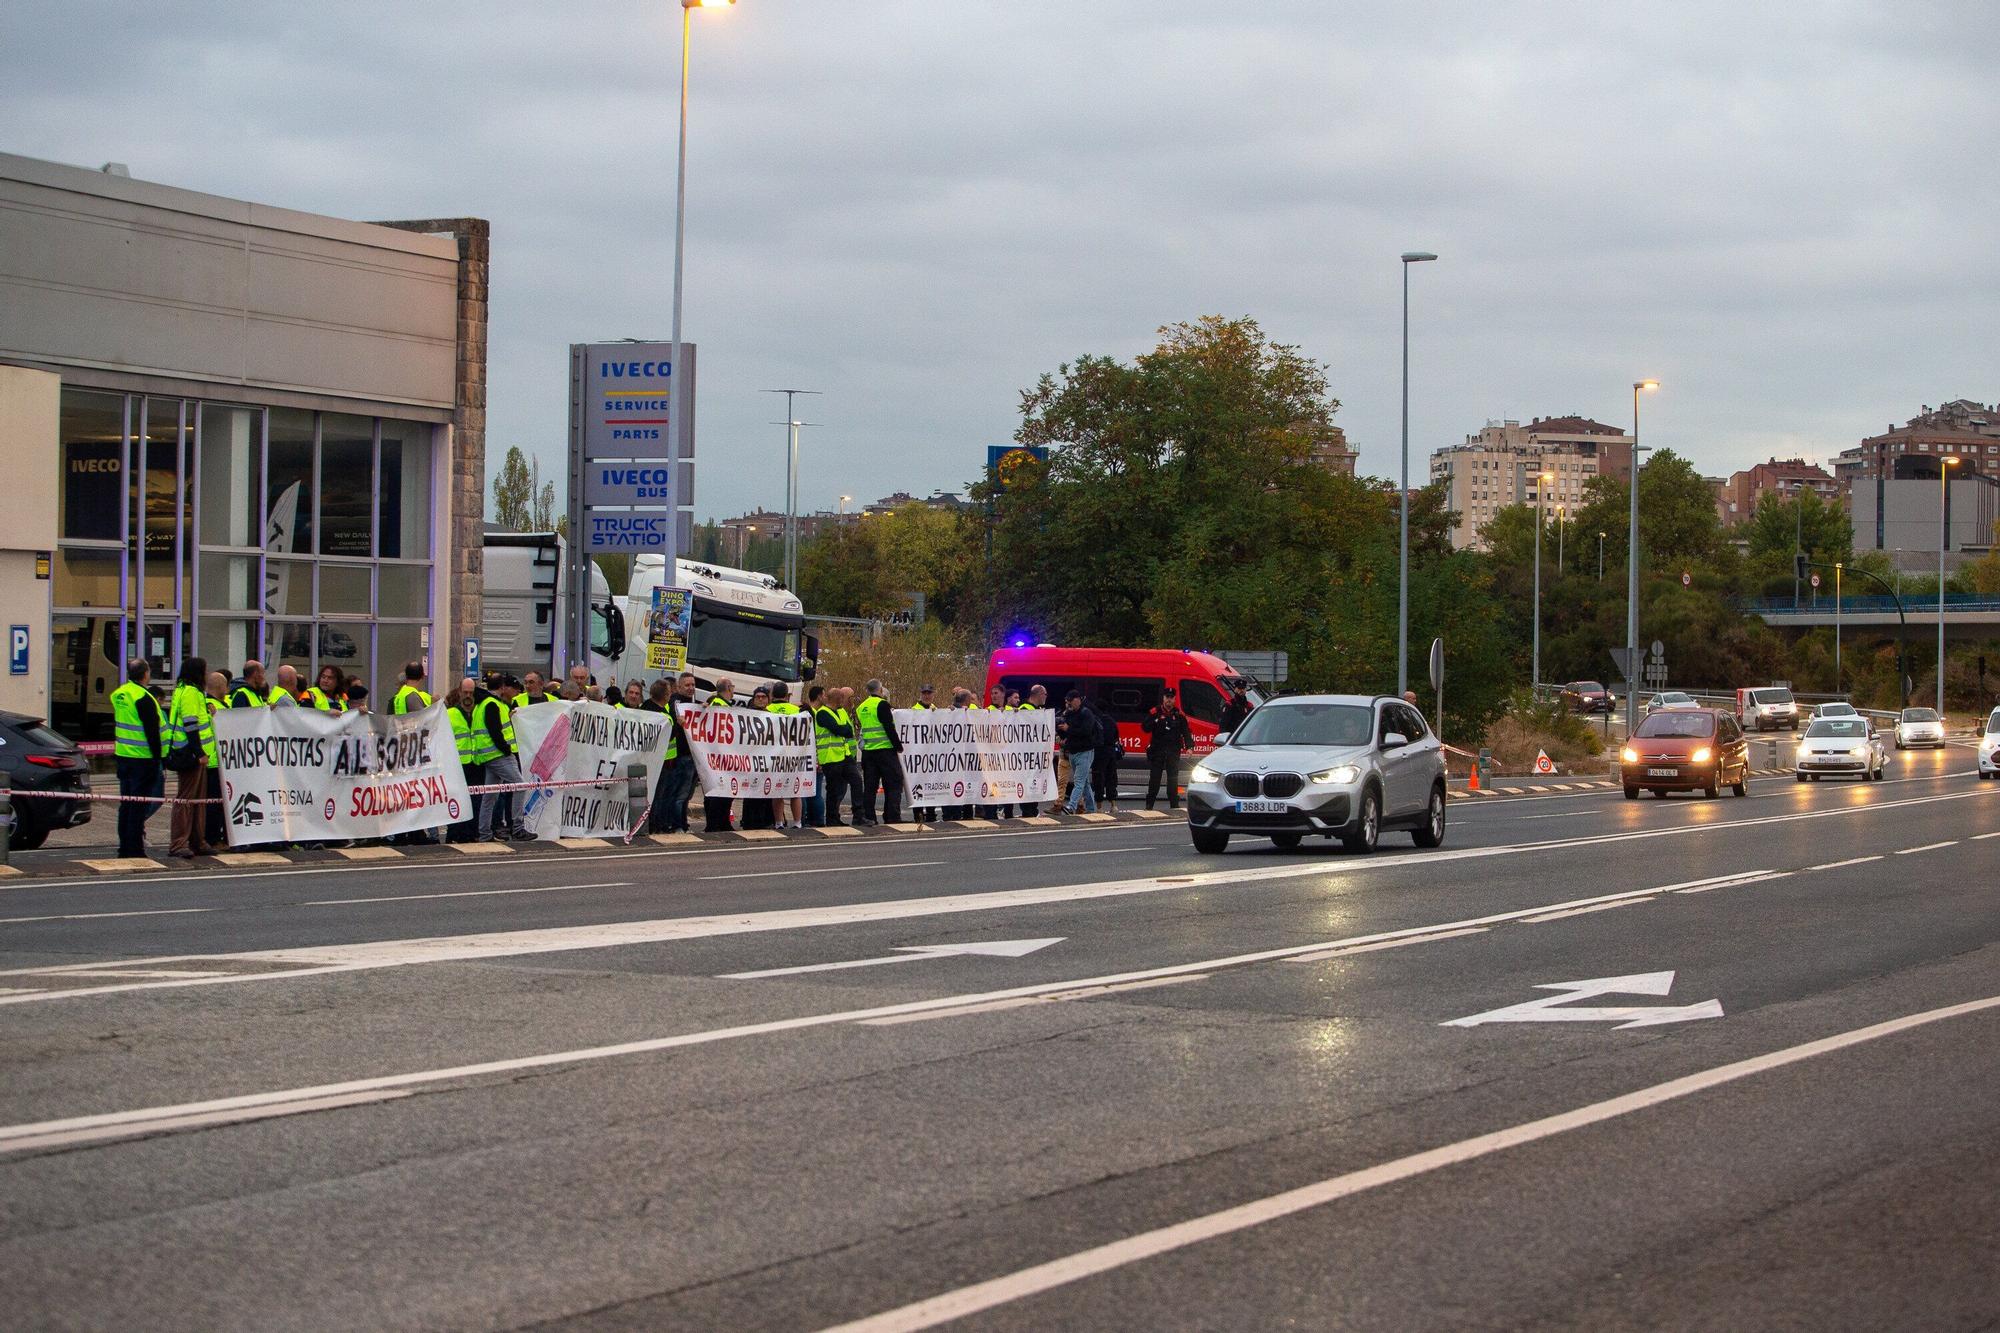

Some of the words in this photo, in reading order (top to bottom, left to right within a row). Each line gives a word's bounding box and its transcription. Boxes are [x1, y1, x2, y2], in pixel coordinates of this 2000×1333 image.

[602, 362, 672, 378] IVECO
[605, 400, 668, 411] SERVICE
[613, 429, 659, 439] PARTS
[72, 459, 121, 473] IVECO
[602, 469, 668, 485] IVECO
[636, 487, 668, 498] BUS
[592, 533, 666, 546] STATIO
[660, 590, 684, 599] DINO
[660, 597, 684, 606] EXPO
[663, 629, 675, 637] 120
[13, 629, 28, 661] P
[653, 646, 679, 655] COMPRA
[466, 641, 478, 667] P
[682, 709, 735, 745] PEAJES
[737, 714, 775, 746] PARA
[900, 724, 910, 744] EL
[1002, 723, 1040, 744] CONTRA
[1123, 737, 1142, 748] 112
[753, 755, 769, 773] DEL
[1007, 752, 1023, 771] LOS
[351, 778, 424, 817] SOLUCIONES
[1242, 802, 1265, 812] 3683
[1267, 802, 1286, 812] LDR
